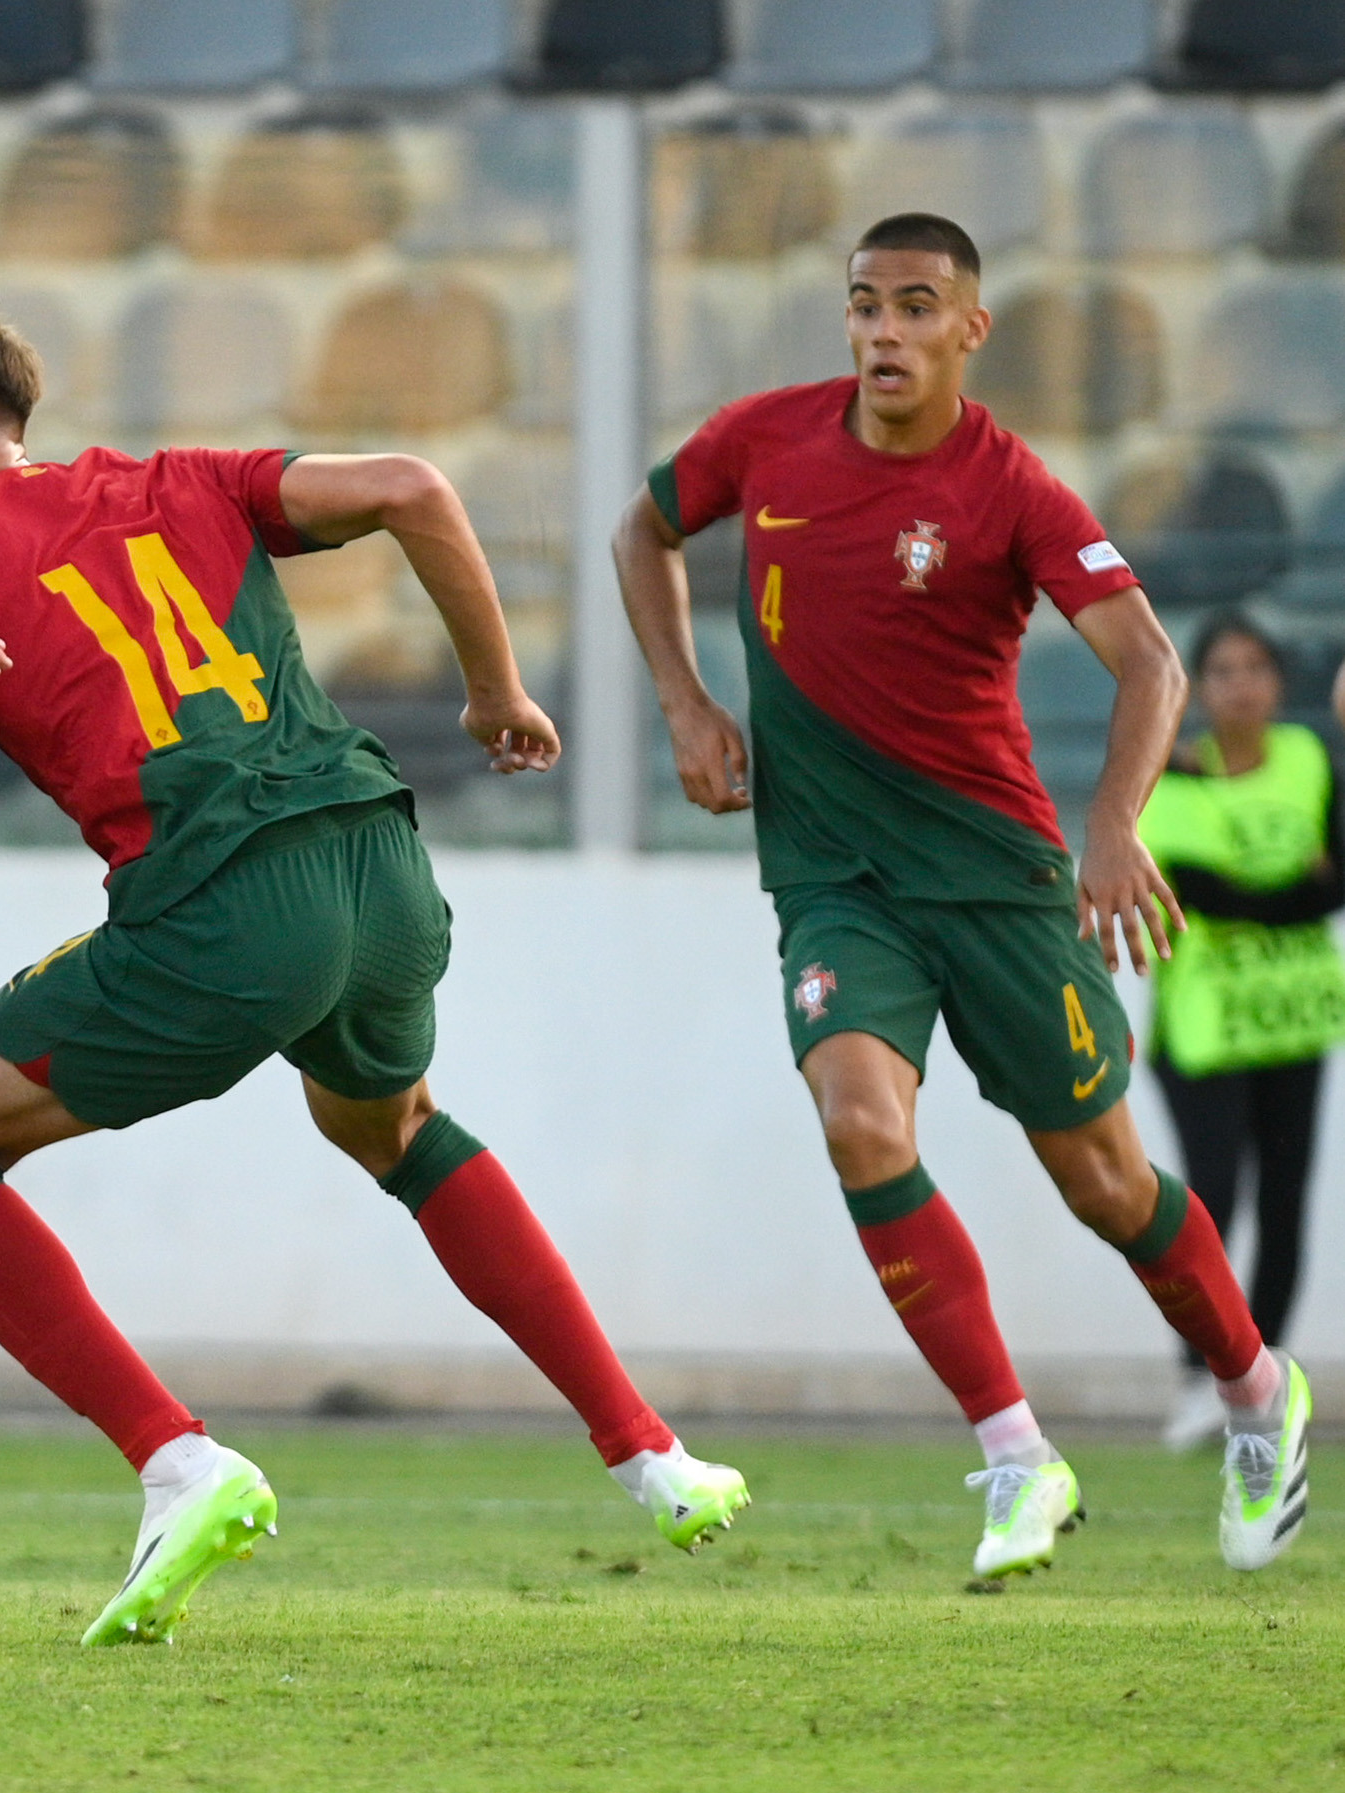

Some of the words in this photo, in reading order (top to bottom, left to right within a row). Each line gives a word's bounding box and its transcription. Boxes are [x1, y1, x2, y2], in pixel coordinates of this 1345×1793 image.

[38, 532, 269, 749] 14
[761, 564, 784, 643] 4
[1063, 982, 1097, 1058] 4
